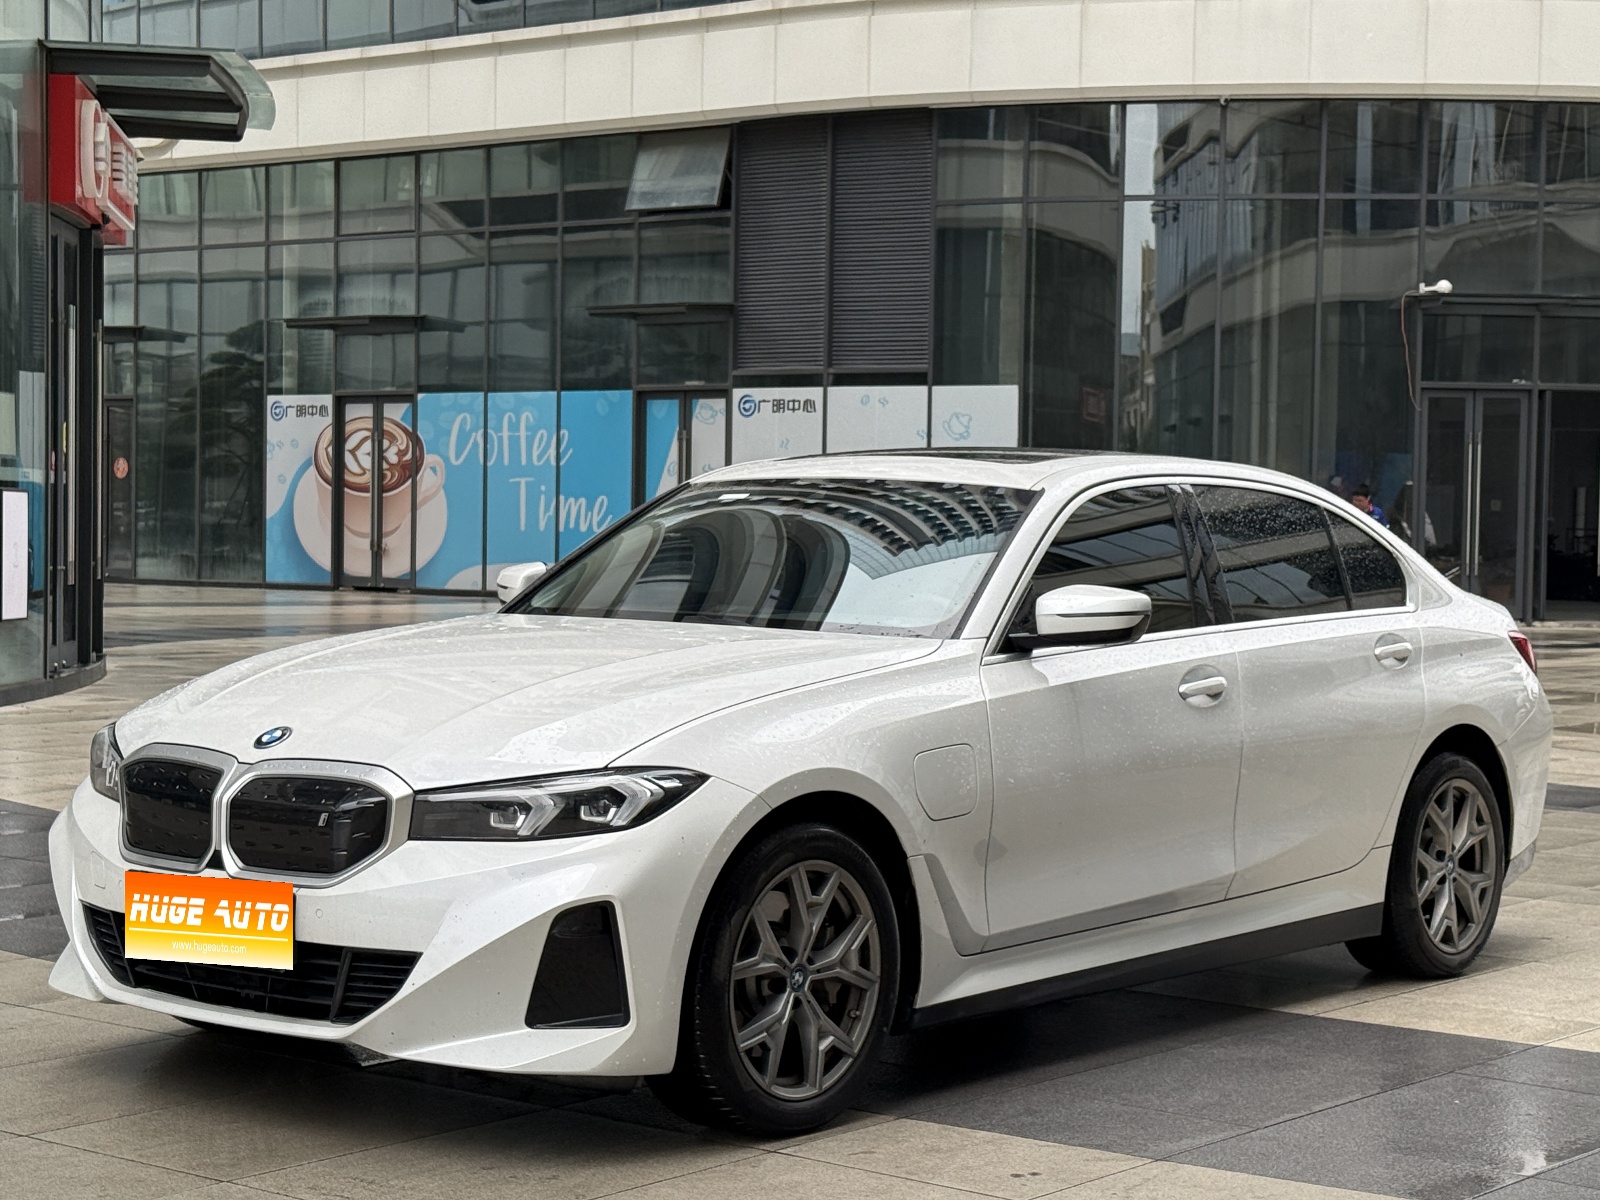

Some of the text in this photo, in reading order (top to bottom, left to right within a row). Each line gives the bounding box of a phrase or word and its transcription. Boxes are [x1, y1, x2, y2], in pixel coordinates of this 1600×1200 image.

[284, 404, 330, 418] 广明中心
[757, 398, 817, 415] 广明中心
[448, 411, 573, 467] Coffee
[509, 476, 613, 533] Time
